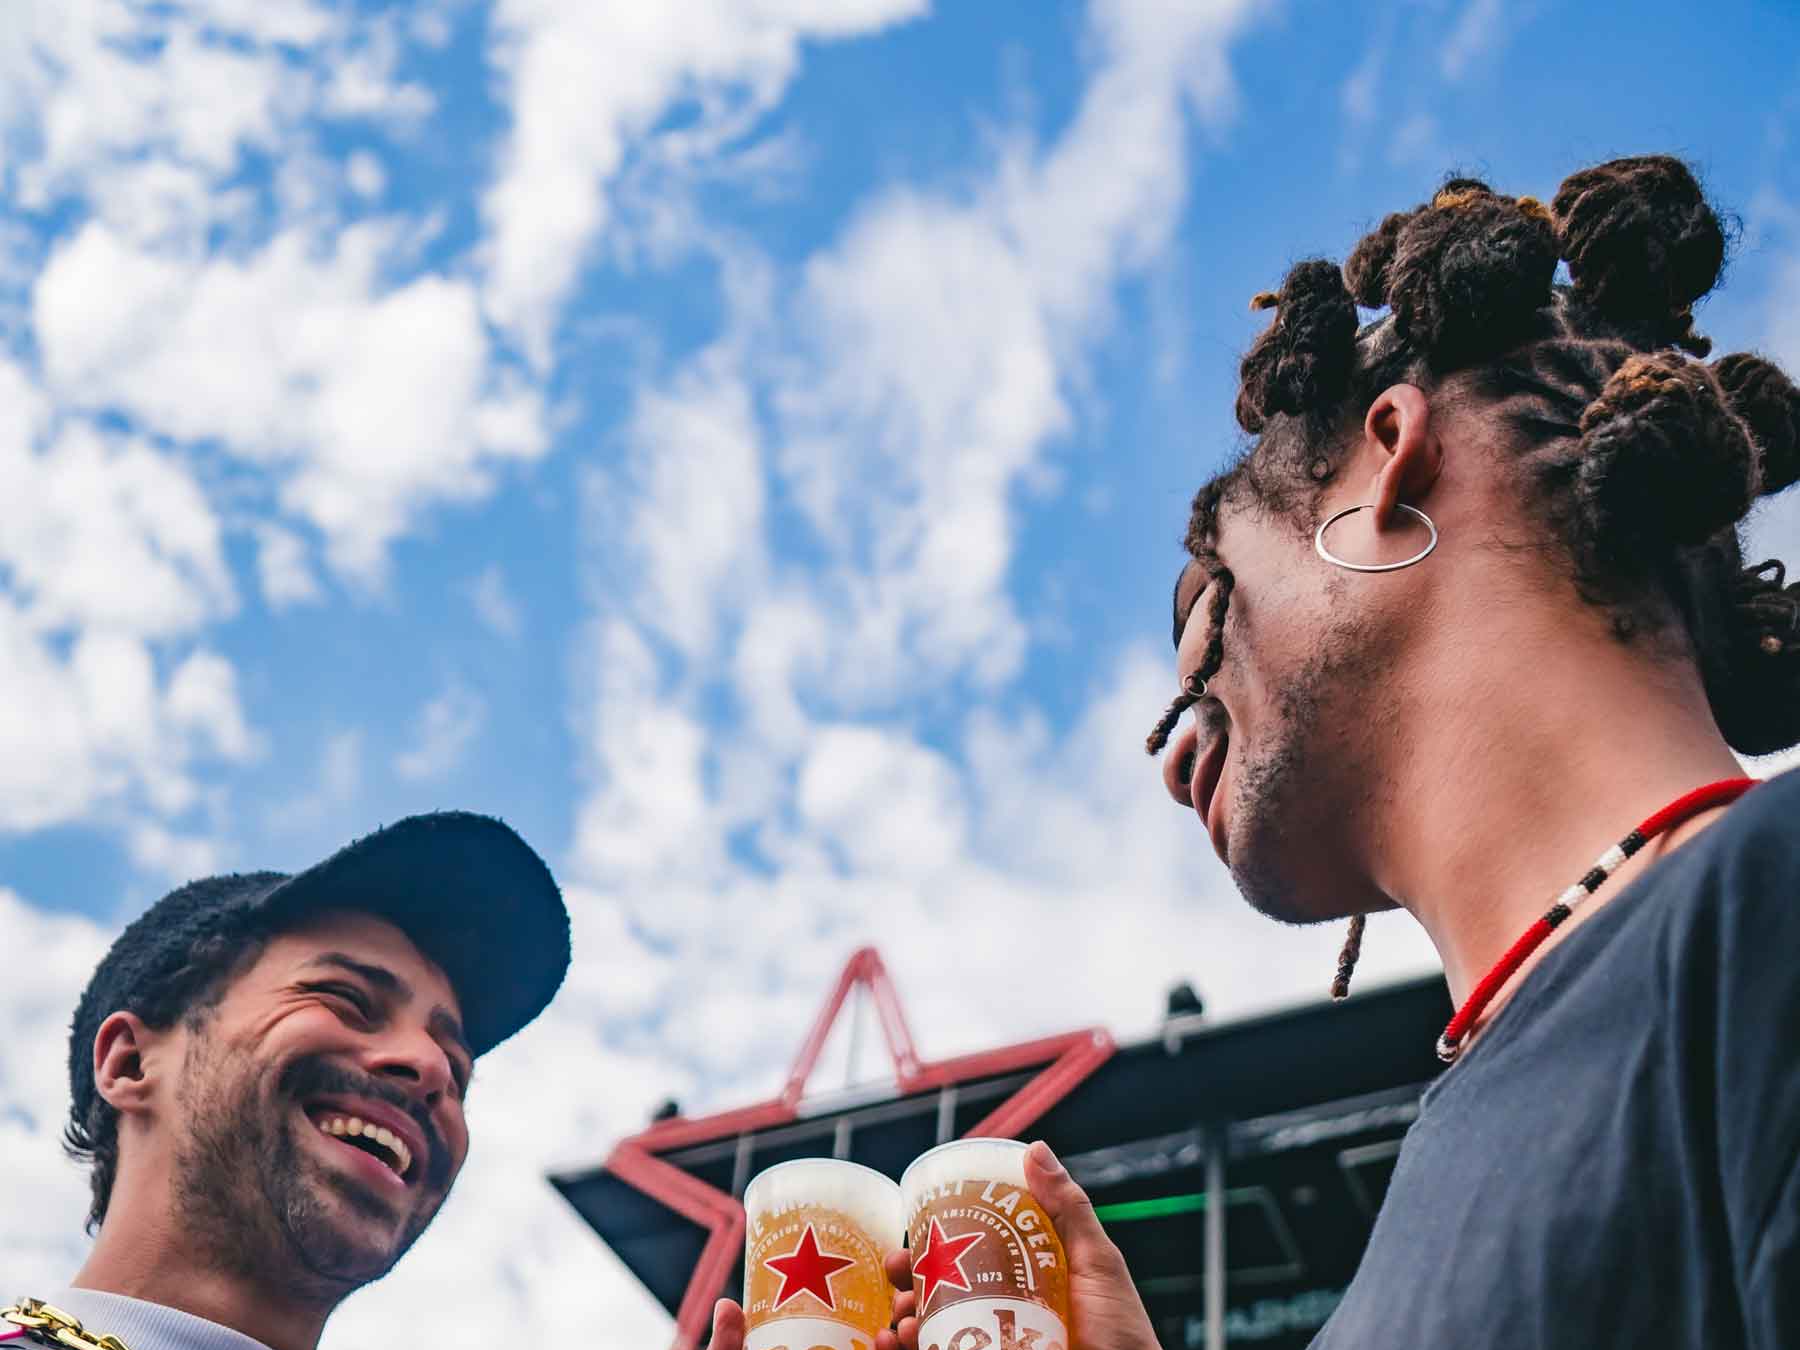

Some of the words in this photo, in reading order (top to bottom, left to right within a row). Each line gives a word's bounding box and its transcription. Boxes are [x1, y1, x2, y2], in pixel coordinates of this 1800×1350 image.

[943, 1208, 1011, 1239] AMSTERDAM
[981, 1182, 1057, 1269] LAGER
[976, 1271, 1003, 1284] 1873
